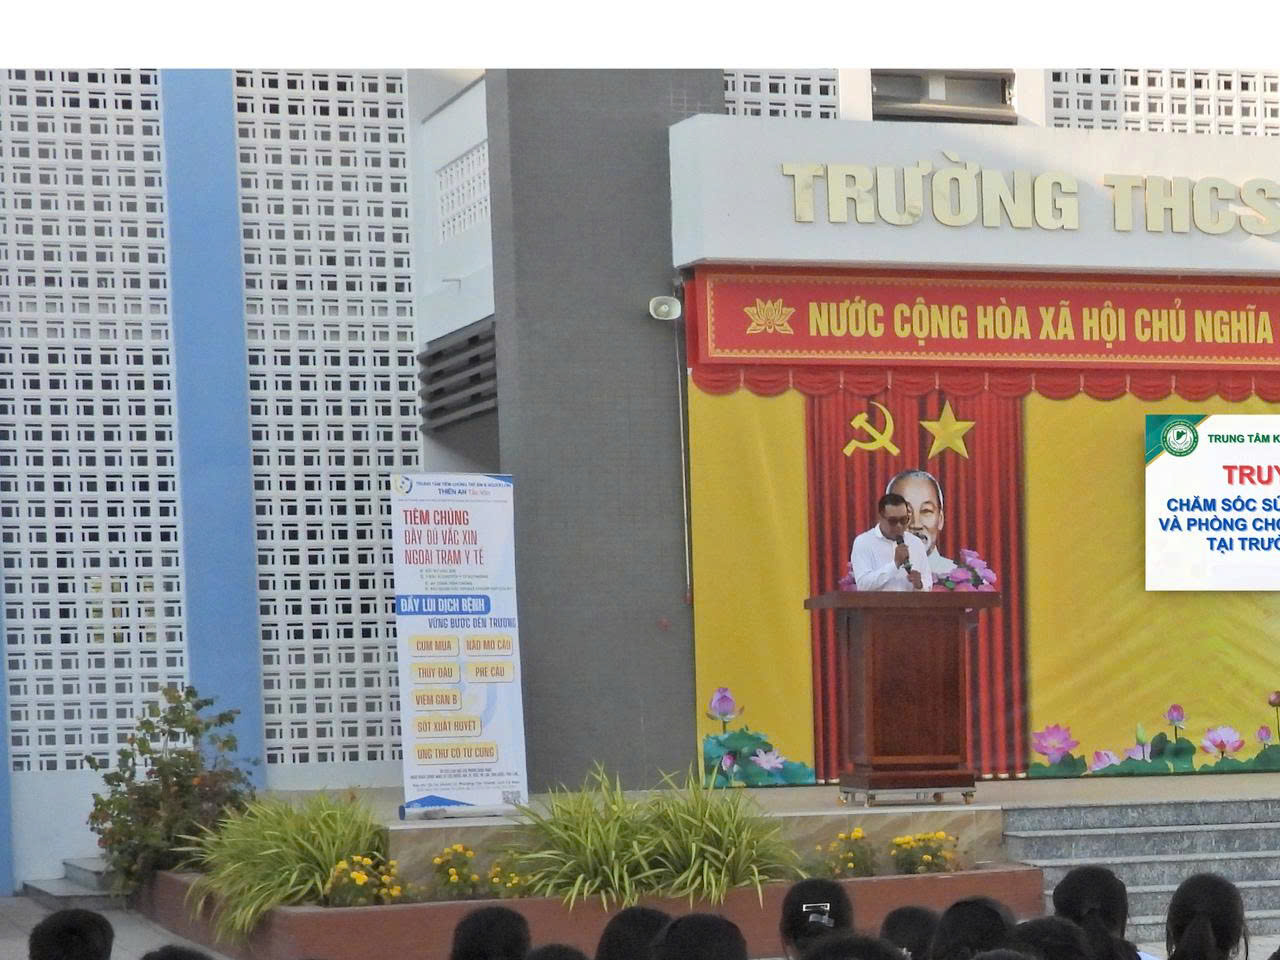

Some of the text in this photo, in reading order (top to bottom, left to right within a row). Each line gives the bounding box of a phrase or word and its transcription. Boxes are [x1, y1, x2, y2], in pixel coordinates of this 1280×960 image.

[782, 151, 1080, 231] TRƯỜNG
[808, 296, 885, 338] NƯỚC
[893, 297, 968, 346] CỘNG
[976, 297, 1031, 340] HÒA
[1039, 300, 1075, 341] XÃ
[1082, 300, 1126, 349] HỘI
[1134, 298, 1186, 343] CHỦ
[1195, 304, 1274, 344] NGHĨA
[1208, 434, 1245, 443] TRUNG
[1247, 433, 1271, 443] TÂM
[1166, 496, 1217, 512] CHĂM
[1221, 495, 1257, 512] SÓC
[1158, 515, 1183, 531] VÀ
[1186, 515, 1248, 531] PHÒNG
[462, 529, 478, 545] XIN
[1206, 537, 1234, 554] TẠI
[464, 549, 470, 565] Y
